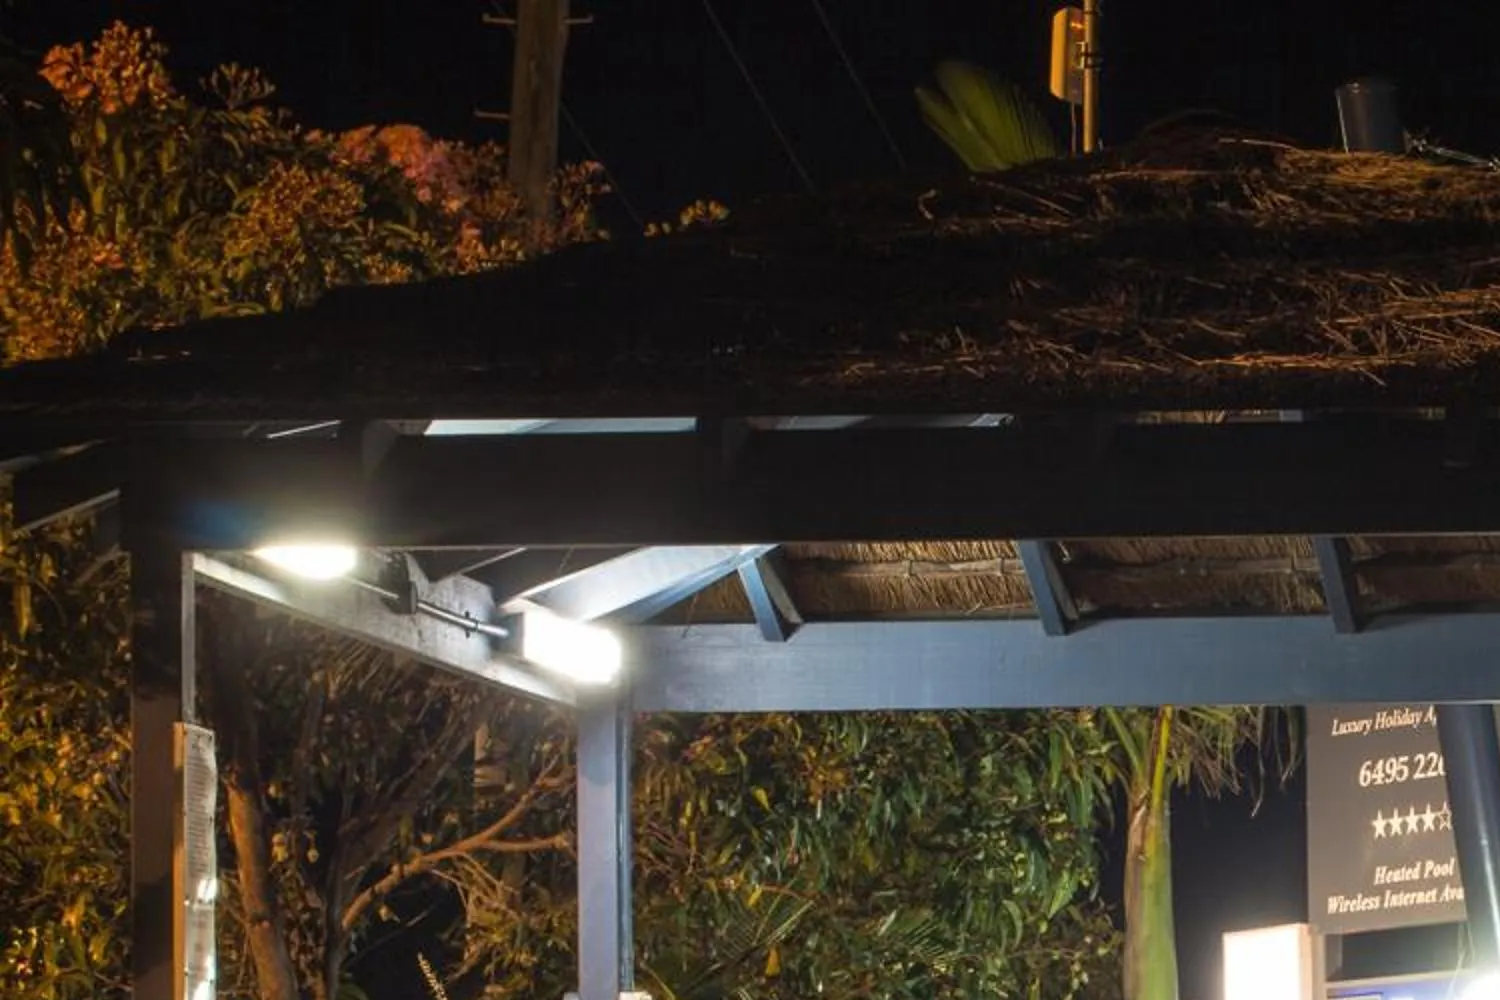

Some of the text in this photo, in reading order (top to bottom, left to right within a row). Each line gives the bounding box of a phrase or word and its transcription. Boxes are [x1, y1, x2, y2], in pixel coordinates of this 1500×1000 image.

[1331, 718, 1372, 736] Luxury
[1374, 706, 1423, 729] Holiday
[1359, 755, 1410, 787] 6495
[1373, 856, 1456, 886] Heated Pool
[1327, 893, 1381, 914] Wireless
[1383, 889, 1438, 908] Internet
